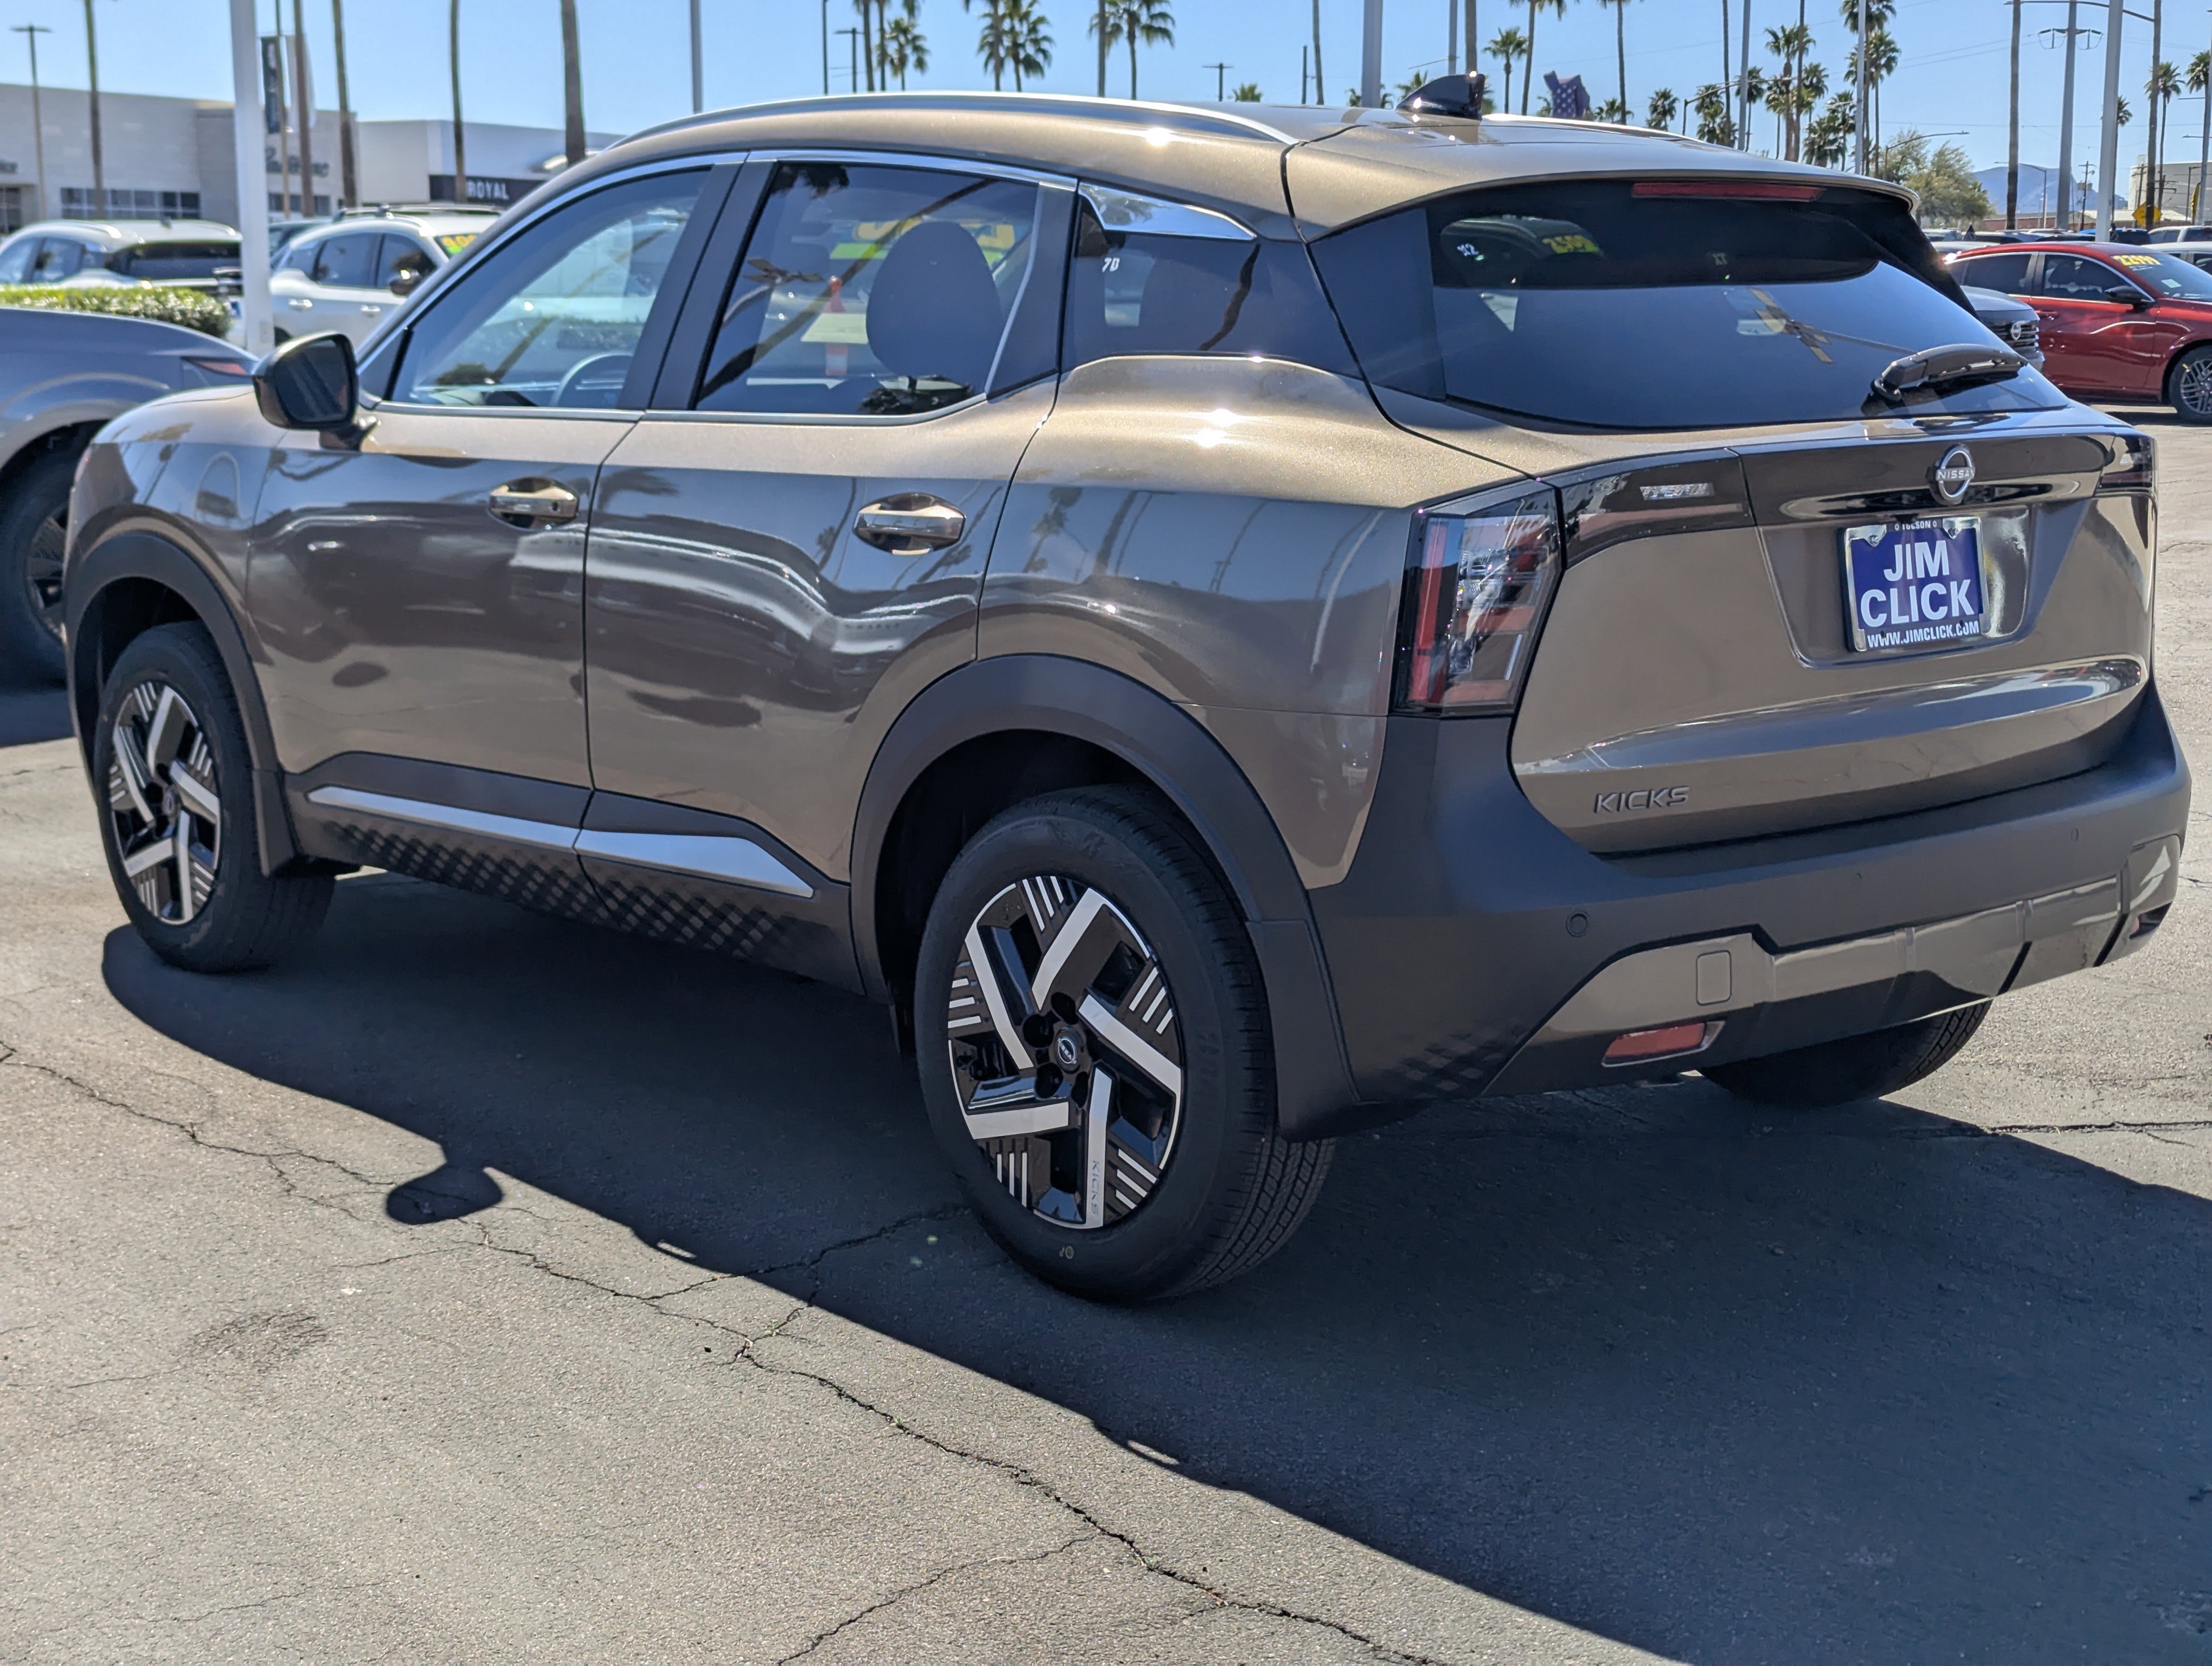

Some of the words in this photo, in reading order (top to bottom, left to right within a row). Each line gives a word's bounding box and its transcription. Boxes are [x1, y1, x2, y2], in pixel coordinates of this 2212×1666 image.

[467, 180, 509, 201] ROYAL
[1938, 469, 1975, 479] NISSAN
[1883, 540, 1950, 582] JIM
[1860, 579, 1975, 627] CLICK
[1867, 620, 1980, 649] WWW.JIMCLICK.COM
[1593, 785, 1690, 813] KICKS
